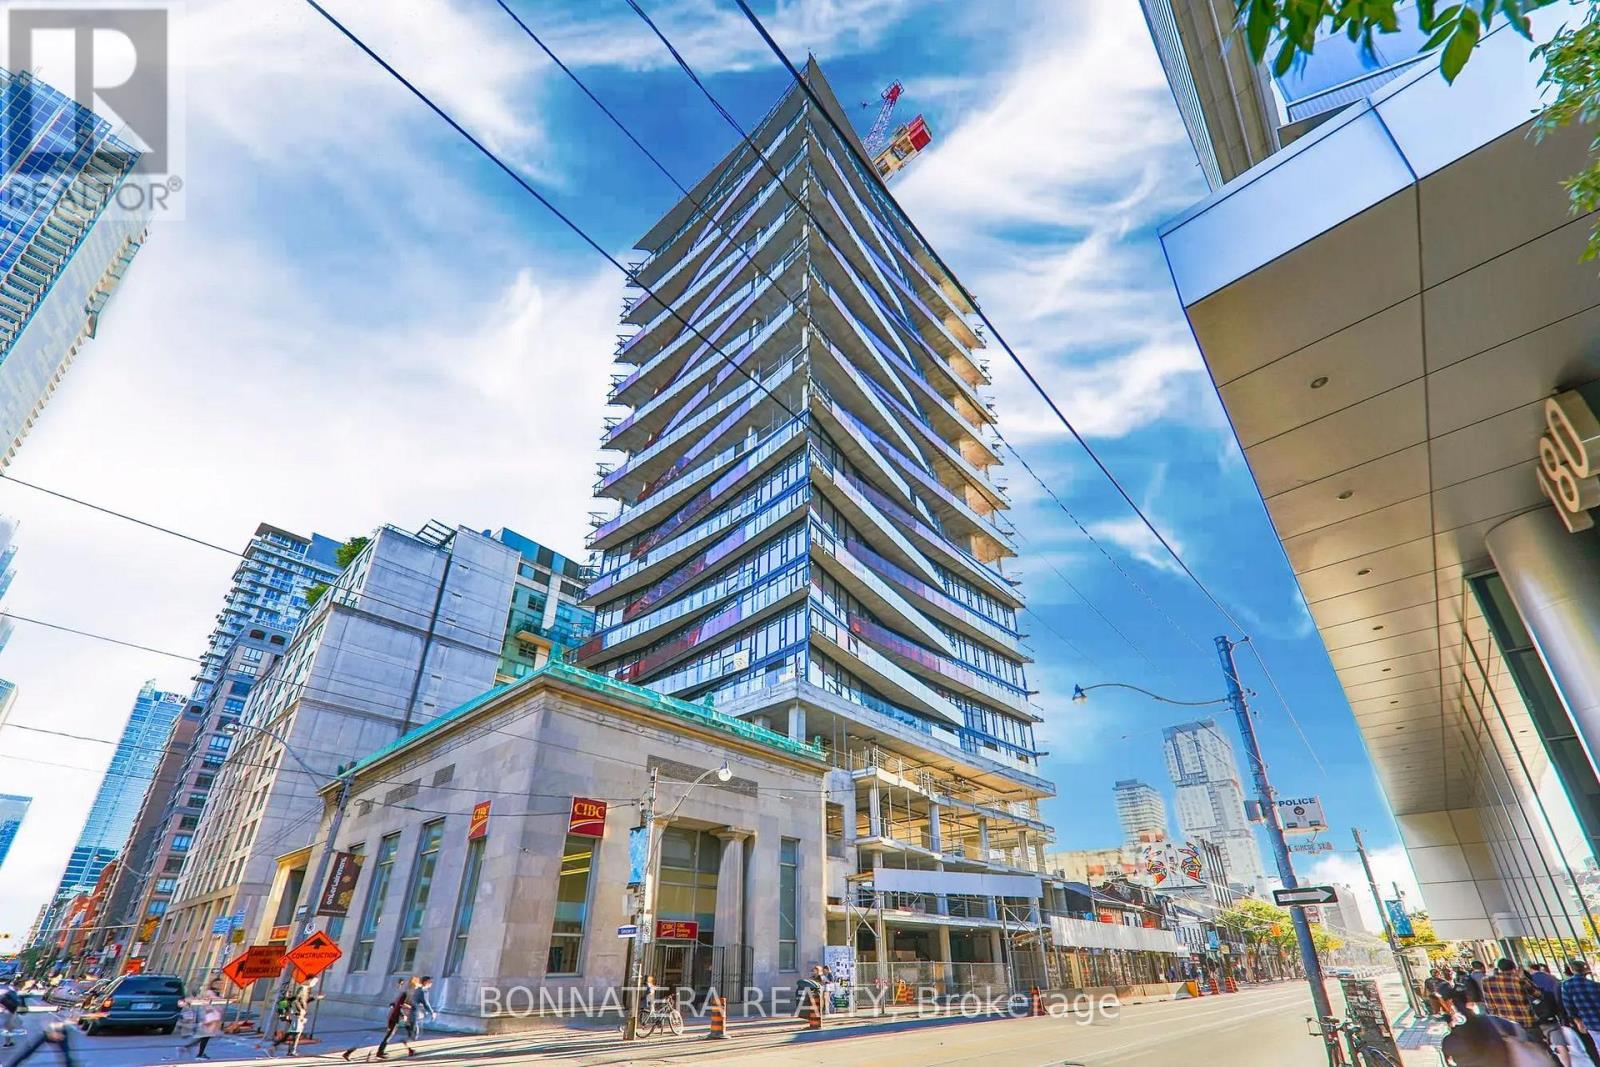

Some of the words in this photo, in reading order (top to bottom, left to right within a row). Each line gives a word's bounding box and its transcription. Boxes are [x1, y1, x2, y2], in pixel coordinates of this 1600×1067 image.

[1536, 397, 1589, 533] 180
[1278, 797, 1317, 807] POLICE
[573, 802, 605, 819] CIBC
[291, 951, 337, 960] CONSTRUCTION
